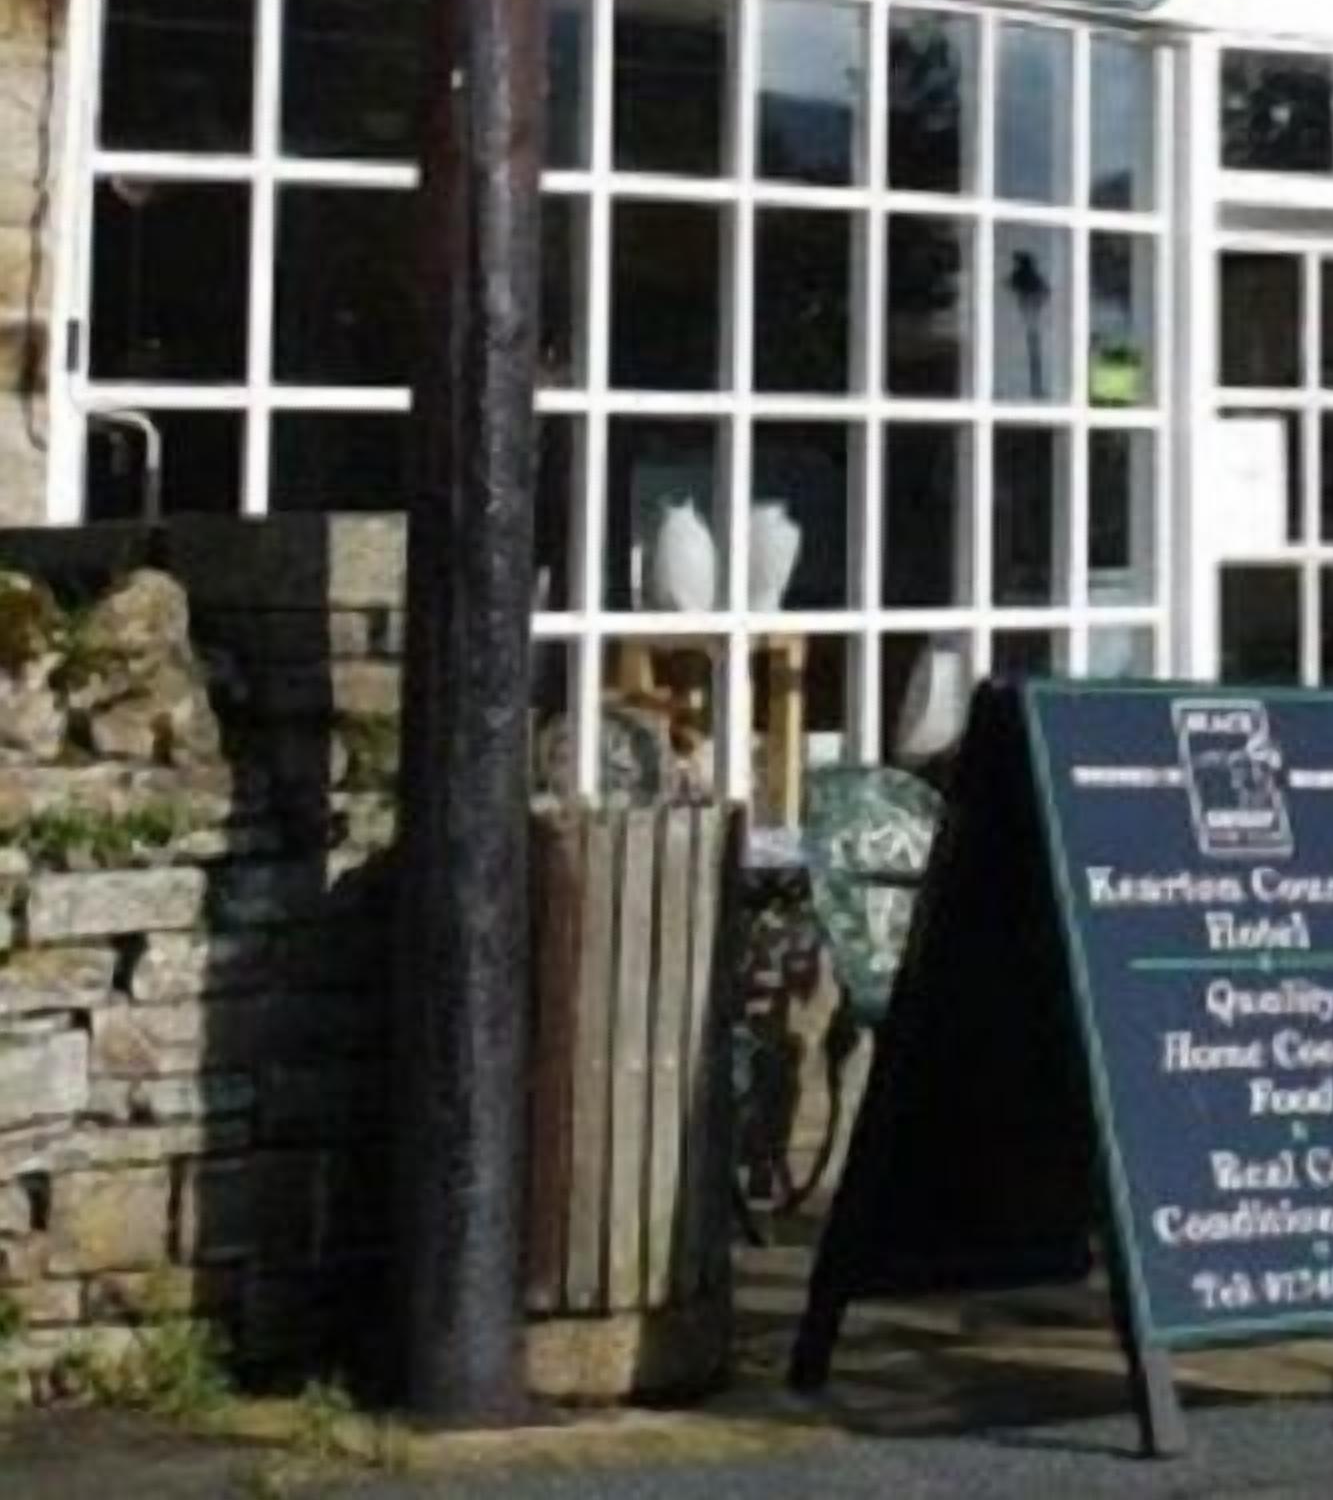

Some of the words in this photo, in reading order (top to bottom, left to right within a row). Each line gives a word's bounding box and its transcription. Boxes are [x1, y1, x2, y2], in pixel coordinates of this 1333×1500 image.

[1204, 911, 1311, 950] Hotel
[1163, 1030, 1264, 1072] Home
[1210, 1149, 1298, 1190] Real
